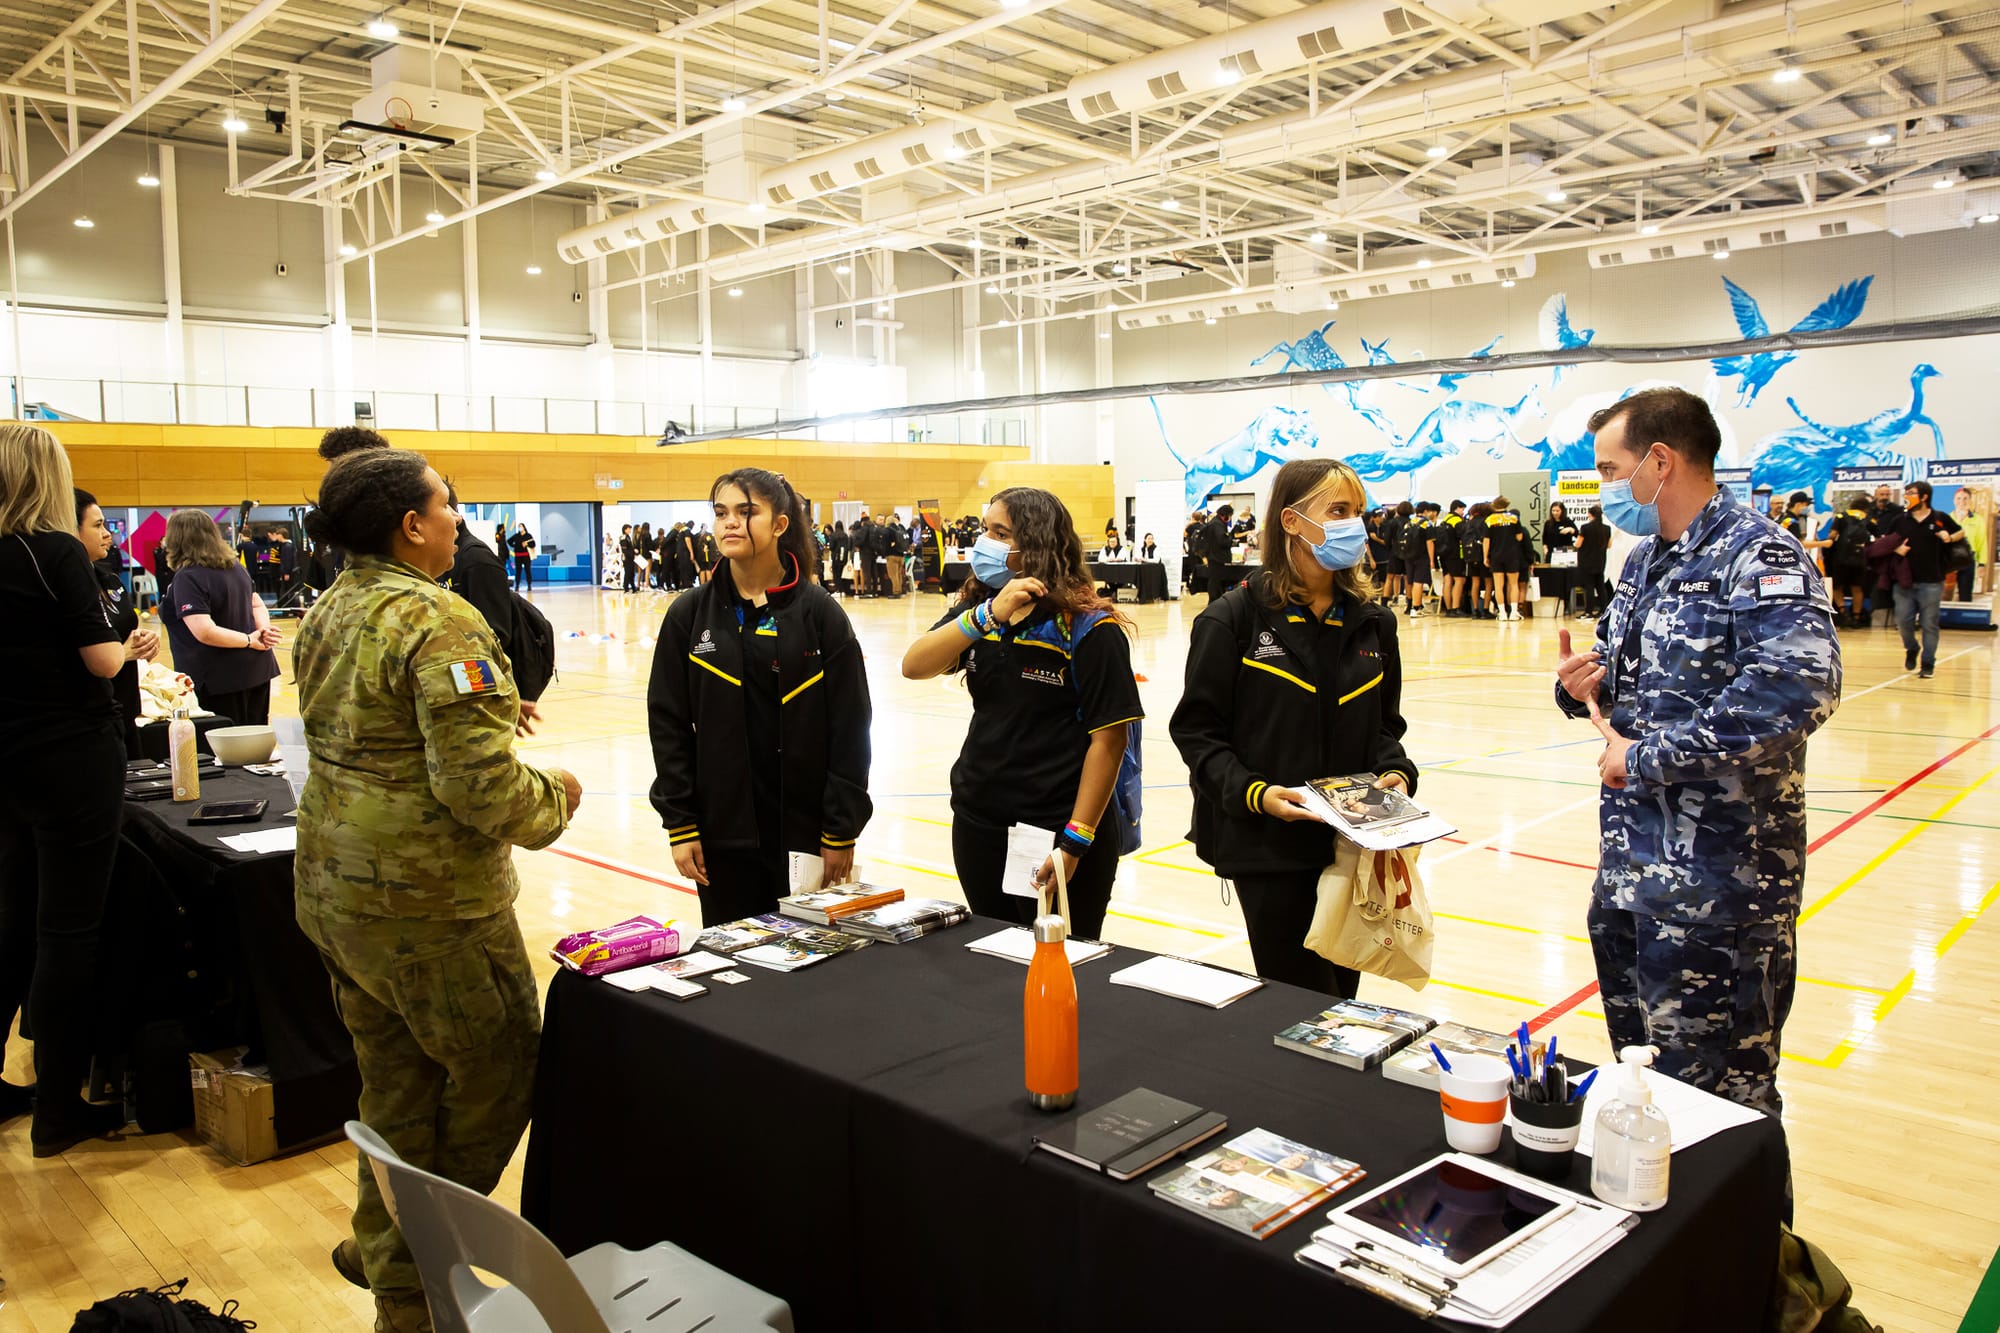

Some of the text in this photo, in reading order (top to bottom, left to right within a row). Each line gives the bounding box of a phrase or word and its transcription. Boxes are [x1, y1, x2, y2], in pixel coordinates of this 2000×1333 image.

[1834, 470, 1863, 481] TAPS
[1929, 464, 1959, 476] TAPS
[1529, 481, 1541, 542] MLSA
[611, 942, 649, 957] Antibacterial
